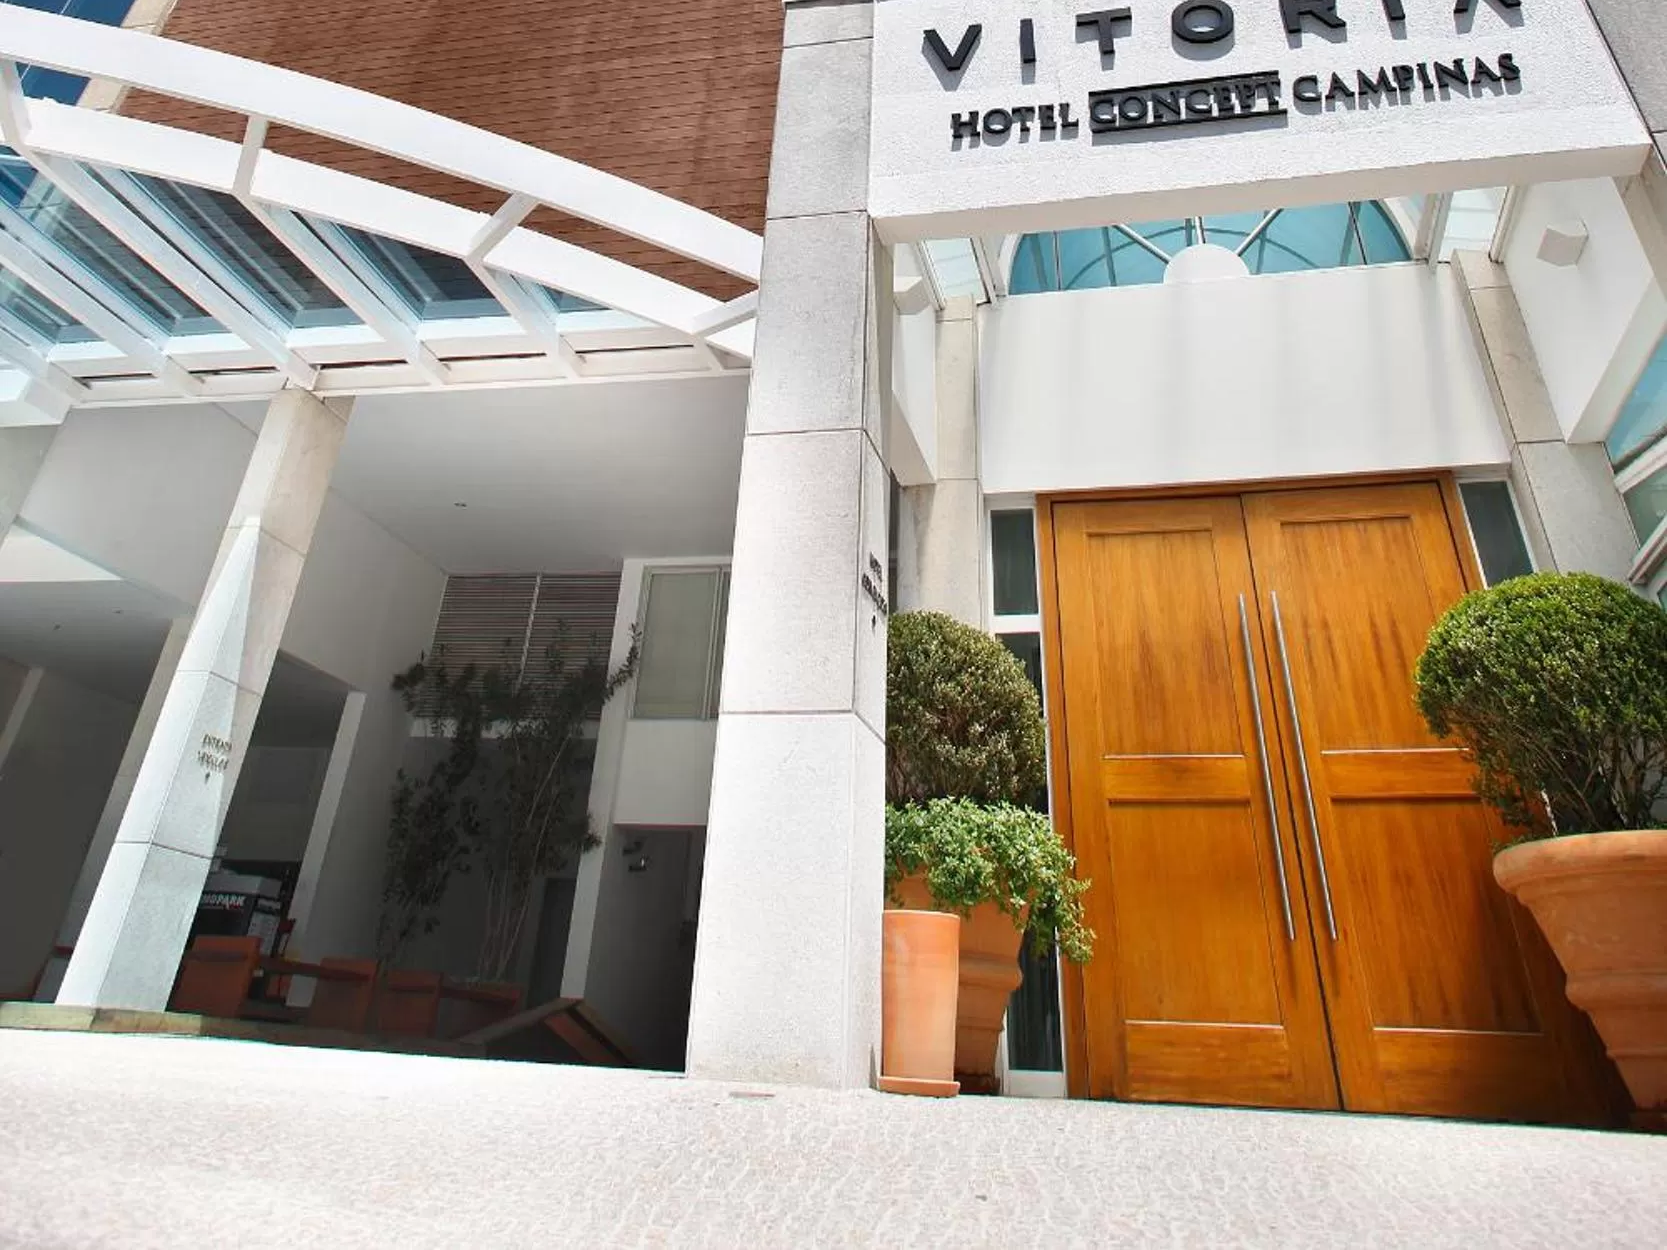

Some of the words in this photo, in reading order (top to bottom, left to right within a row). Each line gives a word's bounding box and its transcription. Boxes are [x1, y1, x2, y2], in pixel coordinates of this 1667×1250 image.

[951, 102, 1079, 139] HOTEL
[1090, 78, 1282, 125] CONCEPT
[1292, 53, 1521, 101] CAMPINAS
